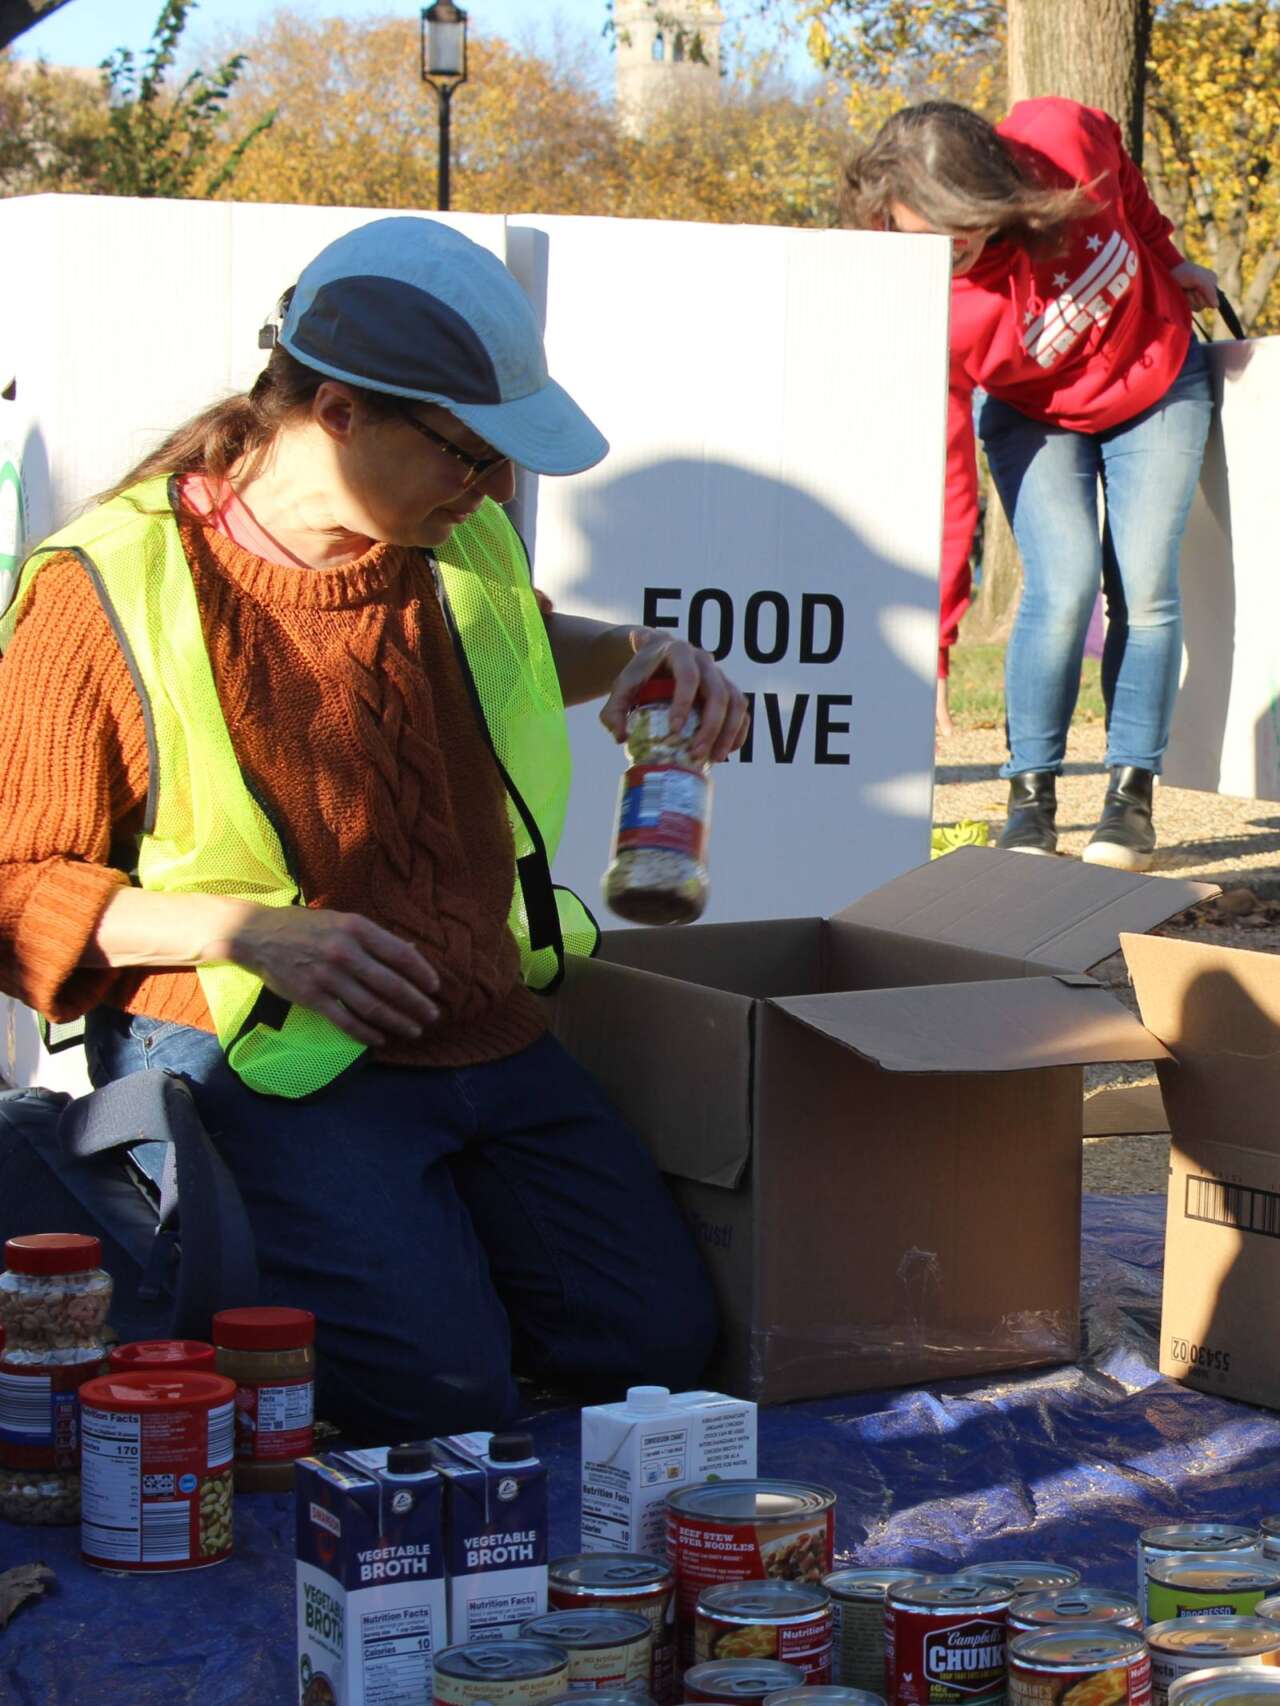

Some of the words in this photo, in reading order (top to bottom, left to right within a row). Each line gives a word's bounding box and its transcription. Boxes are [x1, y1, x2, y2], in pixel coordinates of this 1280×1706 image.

[642, 587, 845, 665] FOOD
[722, 692, 853, 765] IVE
[1172, 1339, 1187, 1361] 02
[1190, 1344, 1231, 1372] 55430
[110, 1412, 139, 1423] Facts
[116, 1446, 138, 1456] 170
[464, 1530, 537, 1549] VEGETABLE
[703, 1532, 734, 1542] STEW
[357, 1544, 431, 1563] VEGETABLE
[467, 1543, 534, 1567] BROTH
[704, 1542, 755, 1552] NOODLES
[360, 1557, 428, 1581] BROTH
[469, 1599, 509, 1610] Nutrition
[511, 1595, 535, 1605] Facts
[305, 1602, 344, 1649] BROTH
[362, 1611, 401, 1625] Nutrition
[403, 1607, 429, 1618] Facts
[783, 1625, 825, 1639] Nutrition
[364, 1645, 397, 1659] Calories
[417, 1638, 430, 1650] 10
[929, 1645, 1008, 1672] CHUNK
